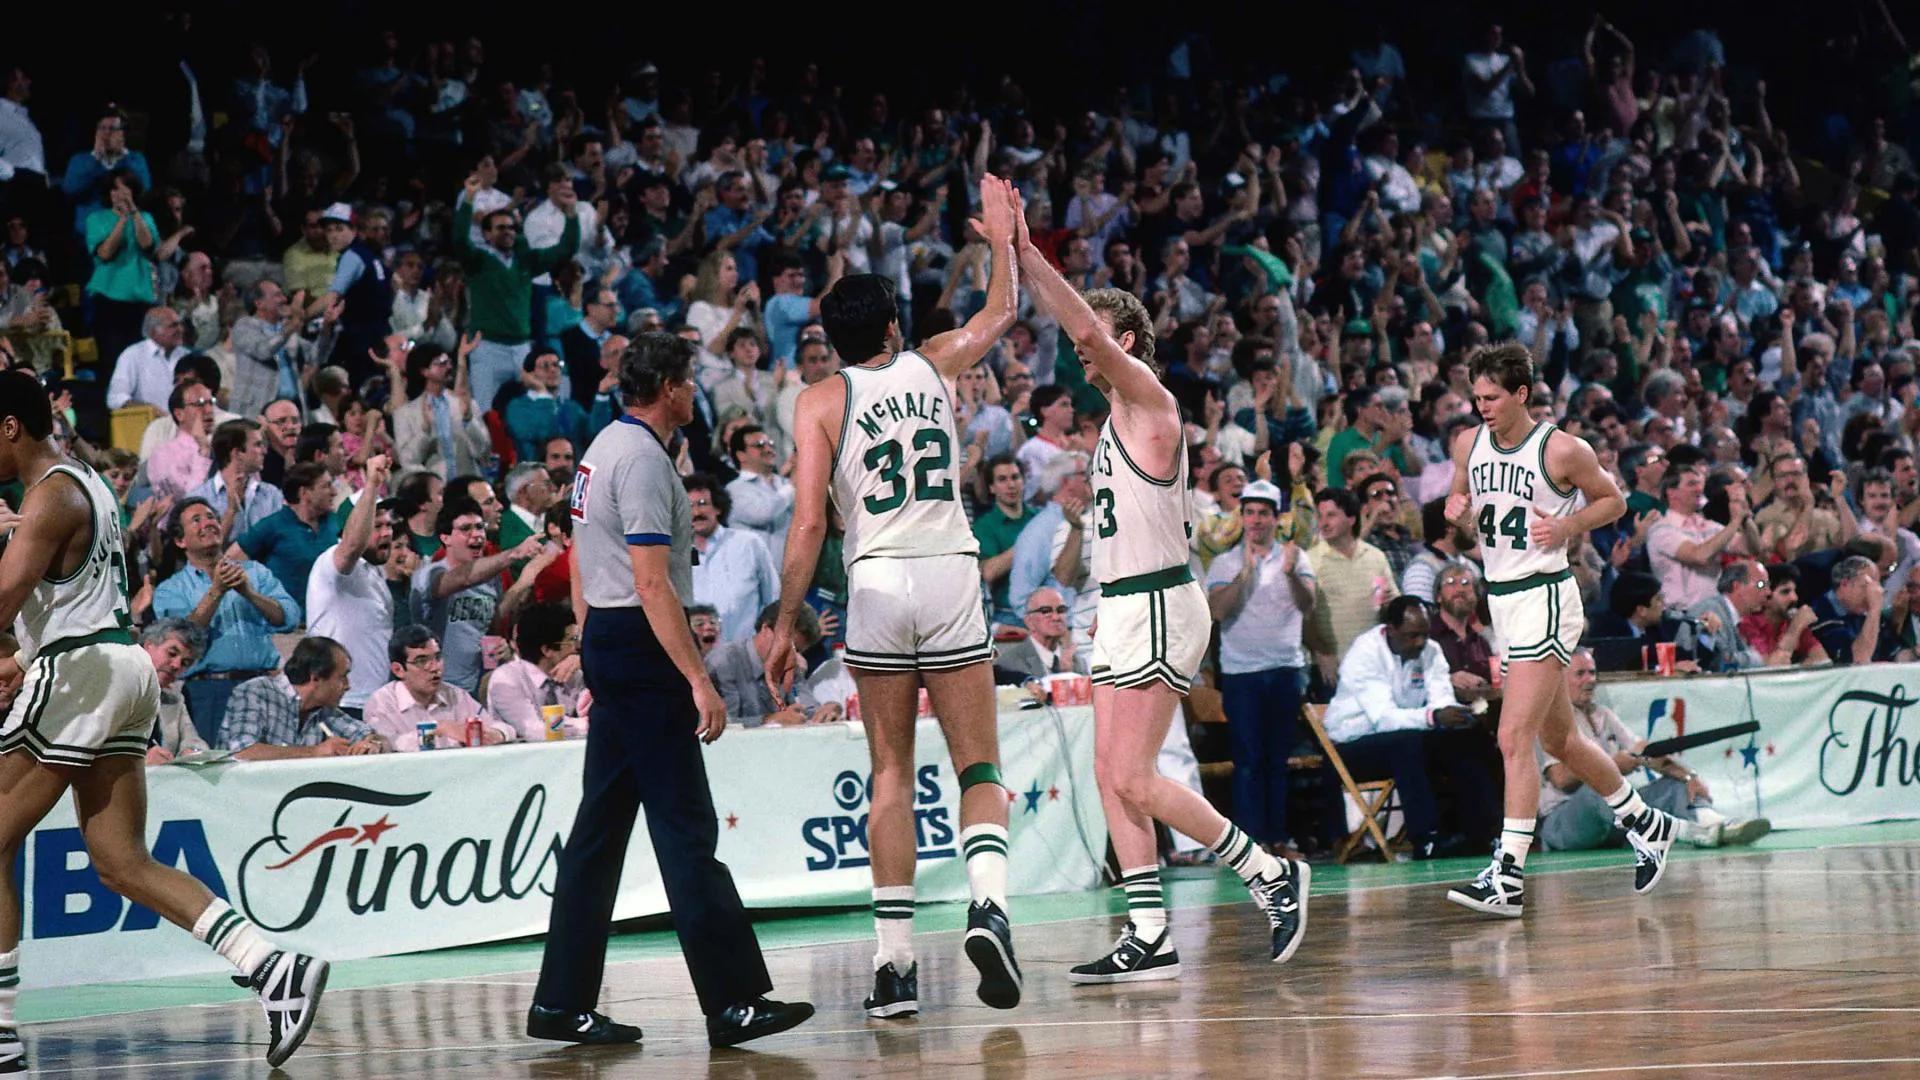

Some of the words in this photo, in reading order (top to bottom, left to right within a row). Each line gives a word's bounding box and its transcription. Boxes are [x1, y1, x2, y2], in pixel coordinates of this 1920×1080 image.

[862, 428, 954, 515] 32
[1472, 462, 1535, 501] CELTICS
[1478, 504, 1527, 550] 44
[801, 807, 955, 871] SPTS
[14, 818, 232, 942] BA
